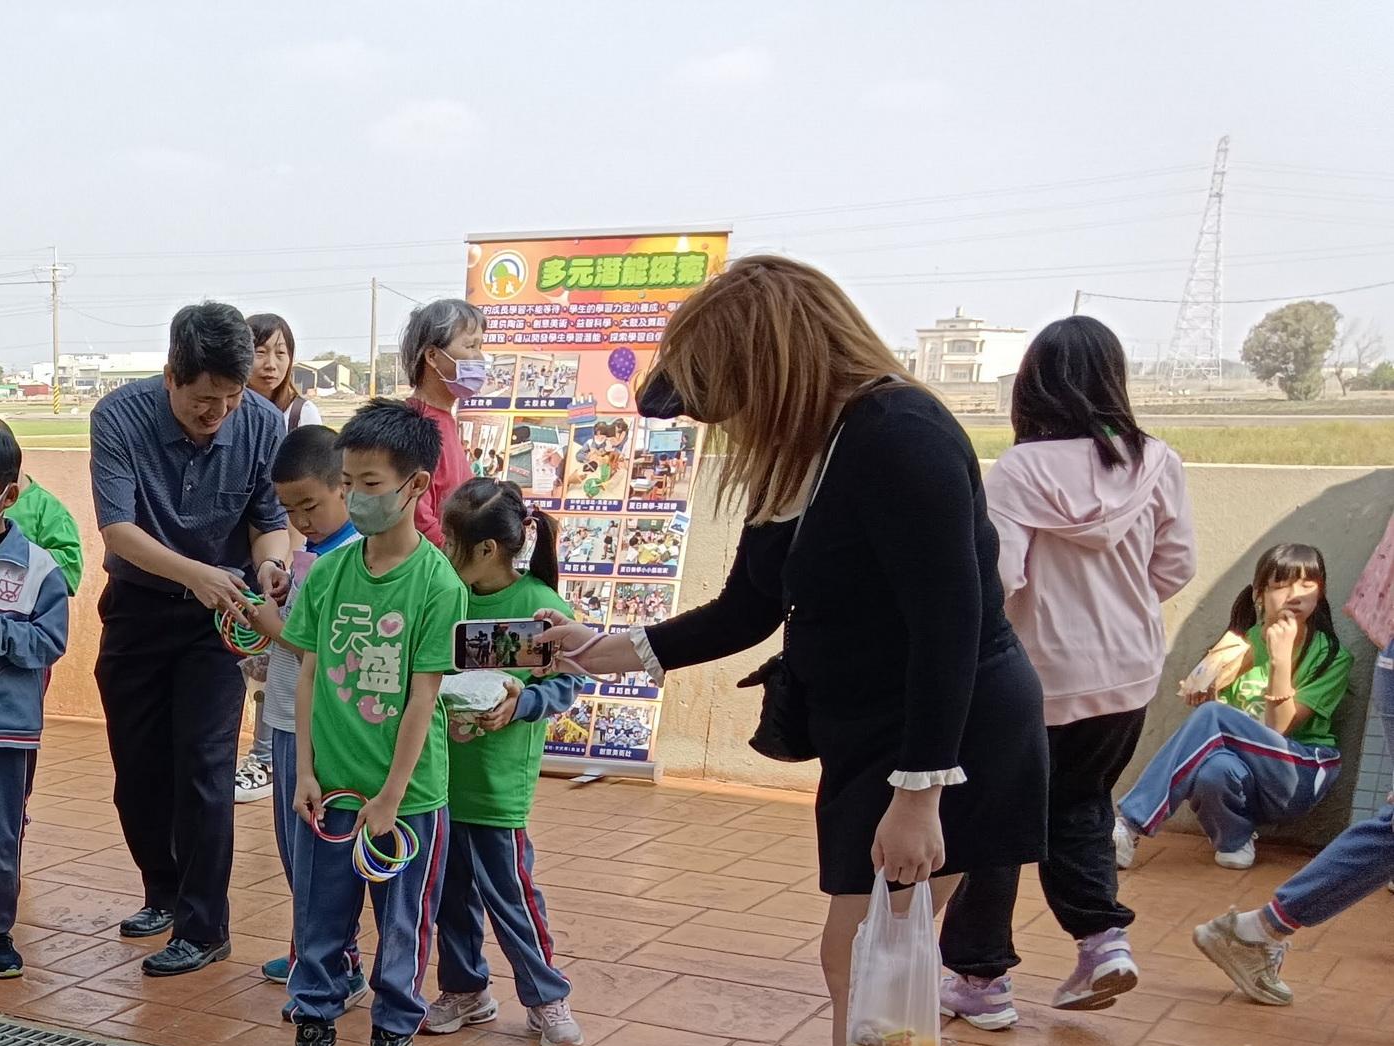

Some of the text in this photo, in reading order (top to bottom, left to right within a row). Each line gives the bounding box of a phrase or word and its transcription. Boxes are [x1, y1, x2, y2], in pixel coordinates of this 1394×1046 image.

[540, 253, 707, 289] 多元潛能探索
